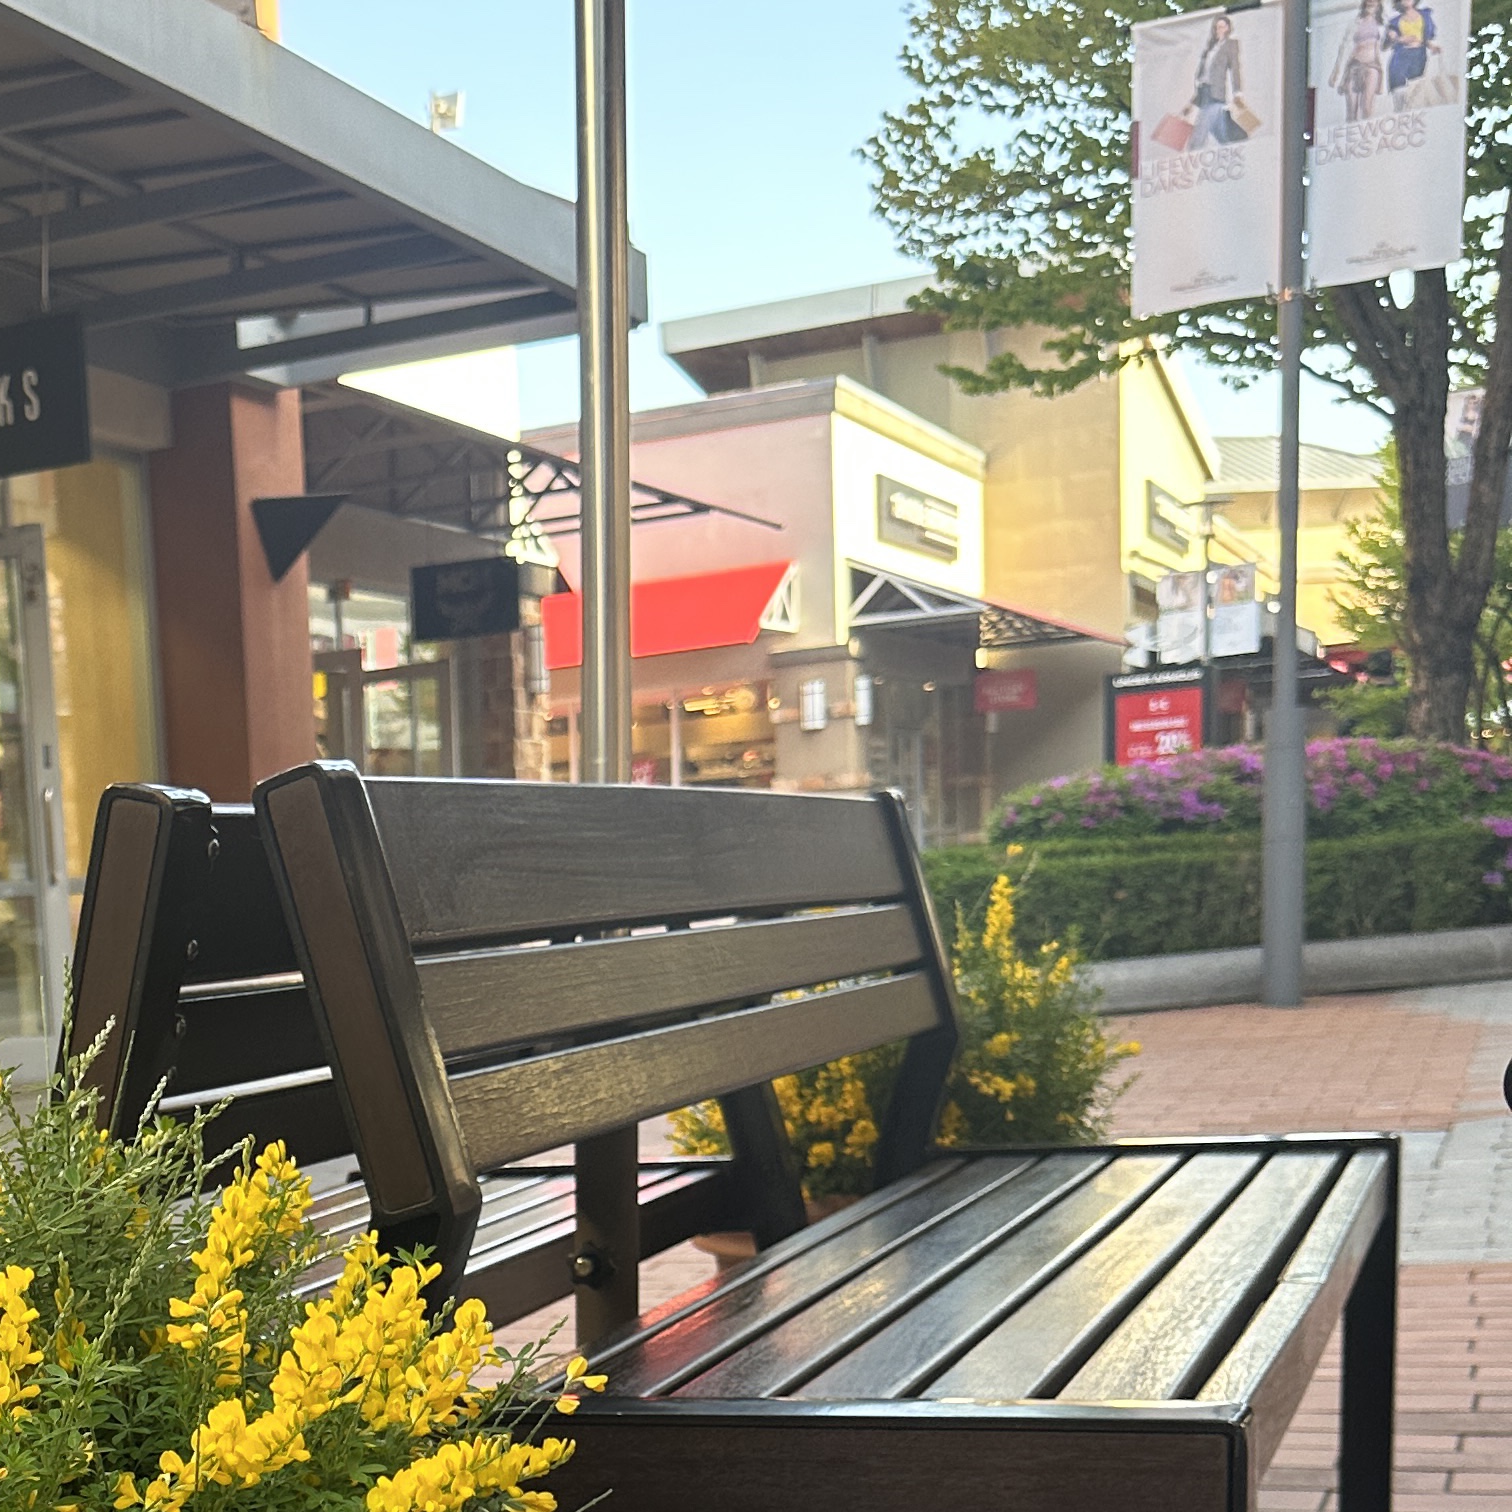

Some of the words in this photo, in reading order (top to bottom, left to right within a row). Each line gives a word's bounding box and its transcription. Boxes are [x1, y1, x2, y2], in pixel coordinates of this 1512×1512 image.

[1315, 111, 1428, 146] LIFEWORK
[1140, 144, 1246, 181] LIFEWORK
[1315, 141, 1373, 165] DAKS
[1375, 129, 1426, 155] ACC
[1140, 173, 1193, 198] DAKS
[1196, 163, 1246, 186] ACC
